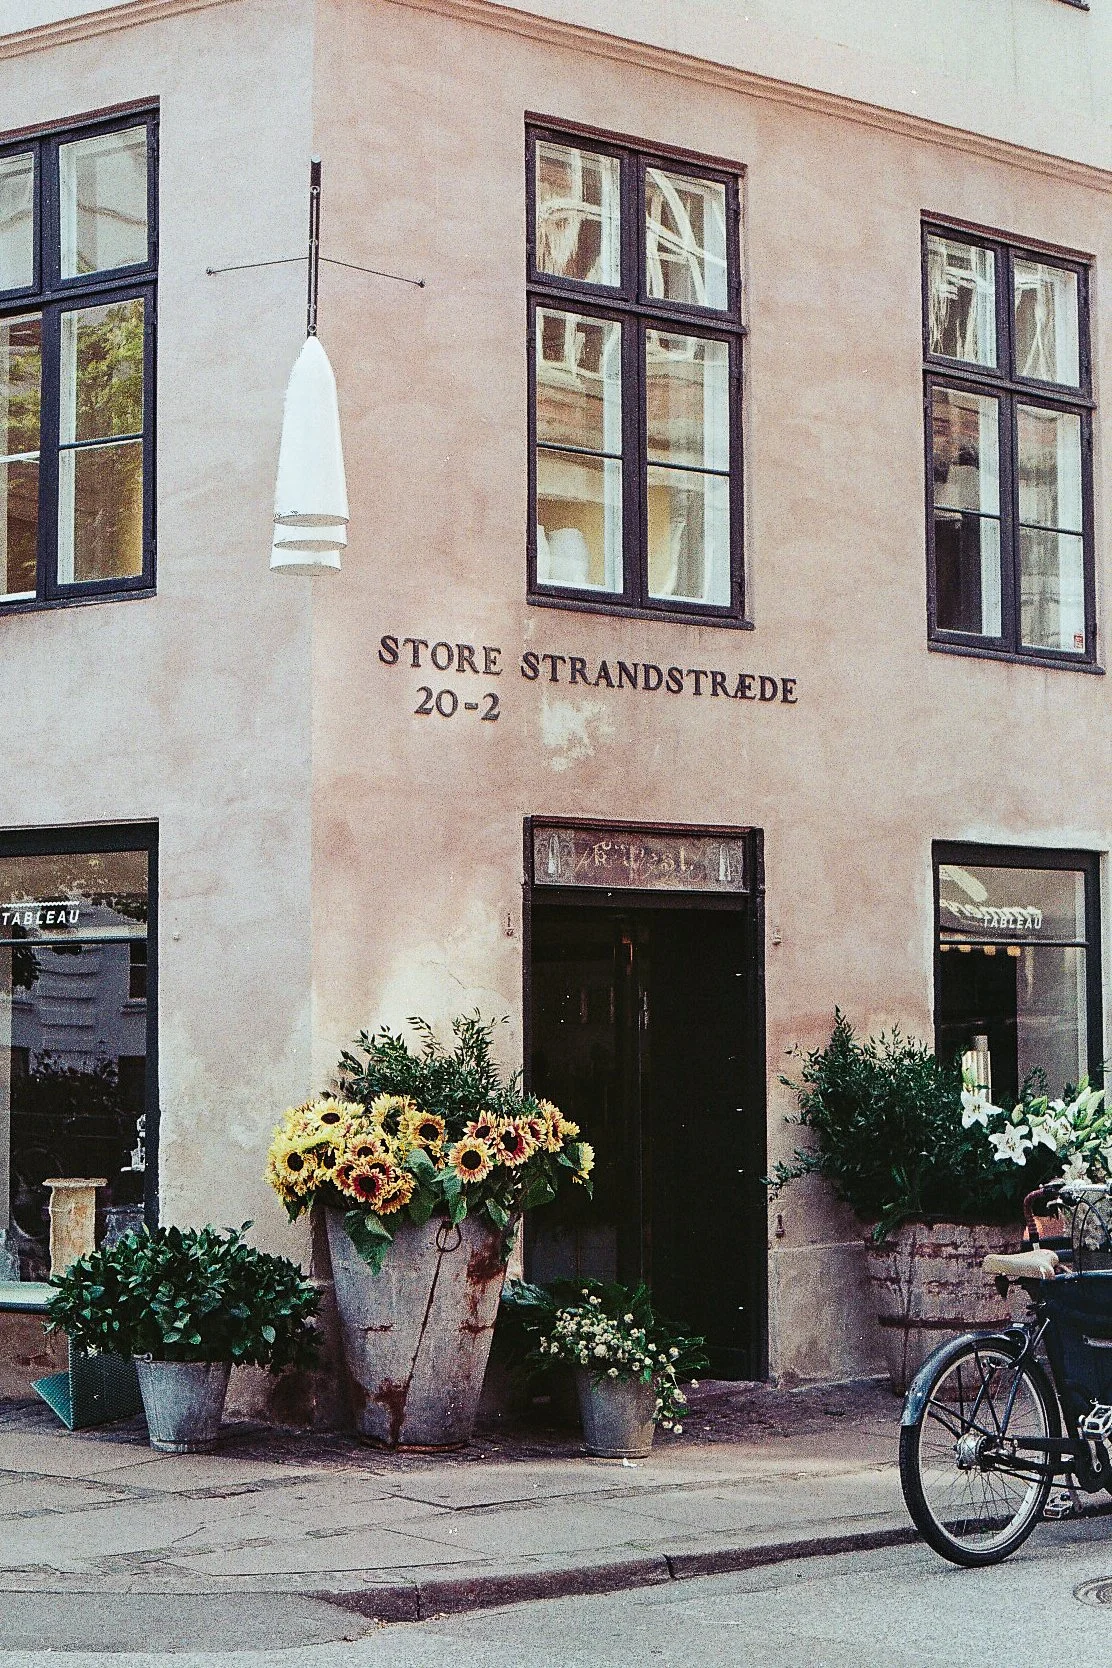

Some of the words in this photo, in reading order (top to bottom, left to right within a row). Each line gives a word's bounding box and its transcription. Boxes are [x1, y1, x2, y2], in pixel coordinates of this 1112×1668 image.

[378, 634, 503, 676] STORE
[520, 651, 799, 705] STRANDSTRÆDE
[414, 686, 501, 721] 20-2
[2, 909, 80, 926] TABLEAU
[983, 915, 1042, 930] TABLEAU
